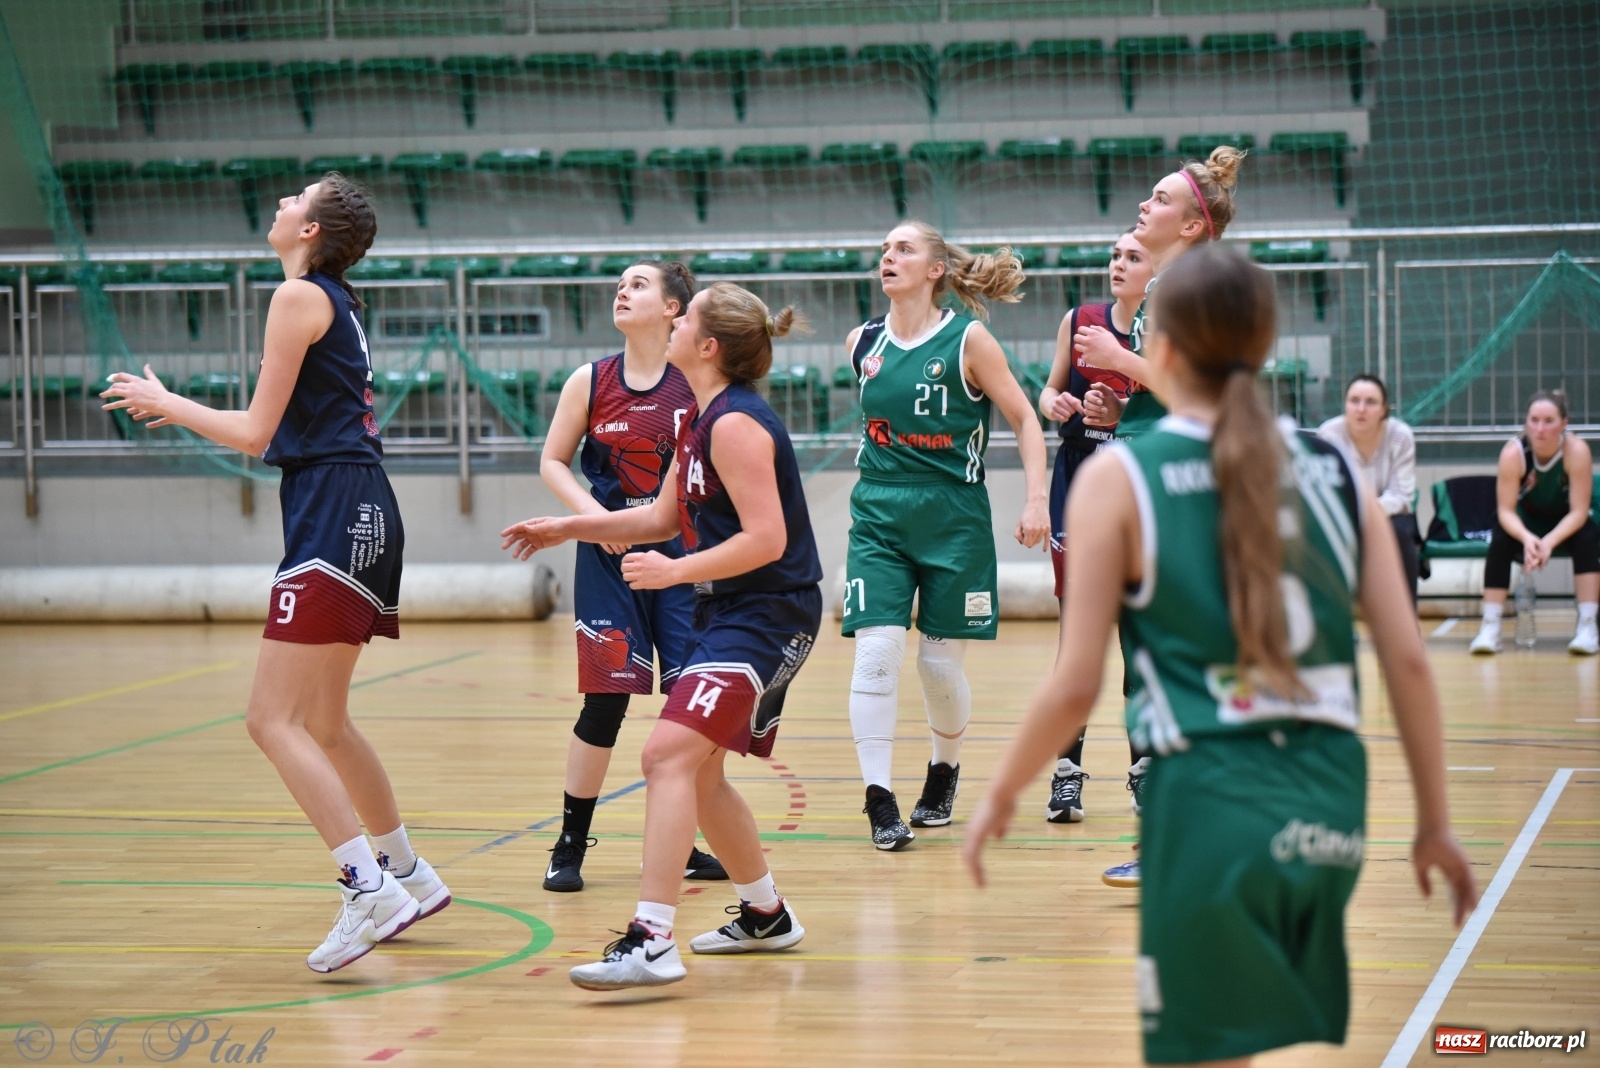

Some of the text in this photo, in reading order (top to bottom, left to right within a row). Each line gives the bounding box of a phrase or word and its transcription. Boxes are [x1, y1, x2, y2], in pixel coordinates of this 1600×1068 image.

[914, 383, 948, 416] 27
[605, 420, 629, 433] DWÓJKA
[898, 433, 954, 449] KAMAN
[687, 455, 706, 495] 14
[276, 591, 296, 624] 9
[844, 578, 865, 618] 27
[686, 680, 723, 718] 14
